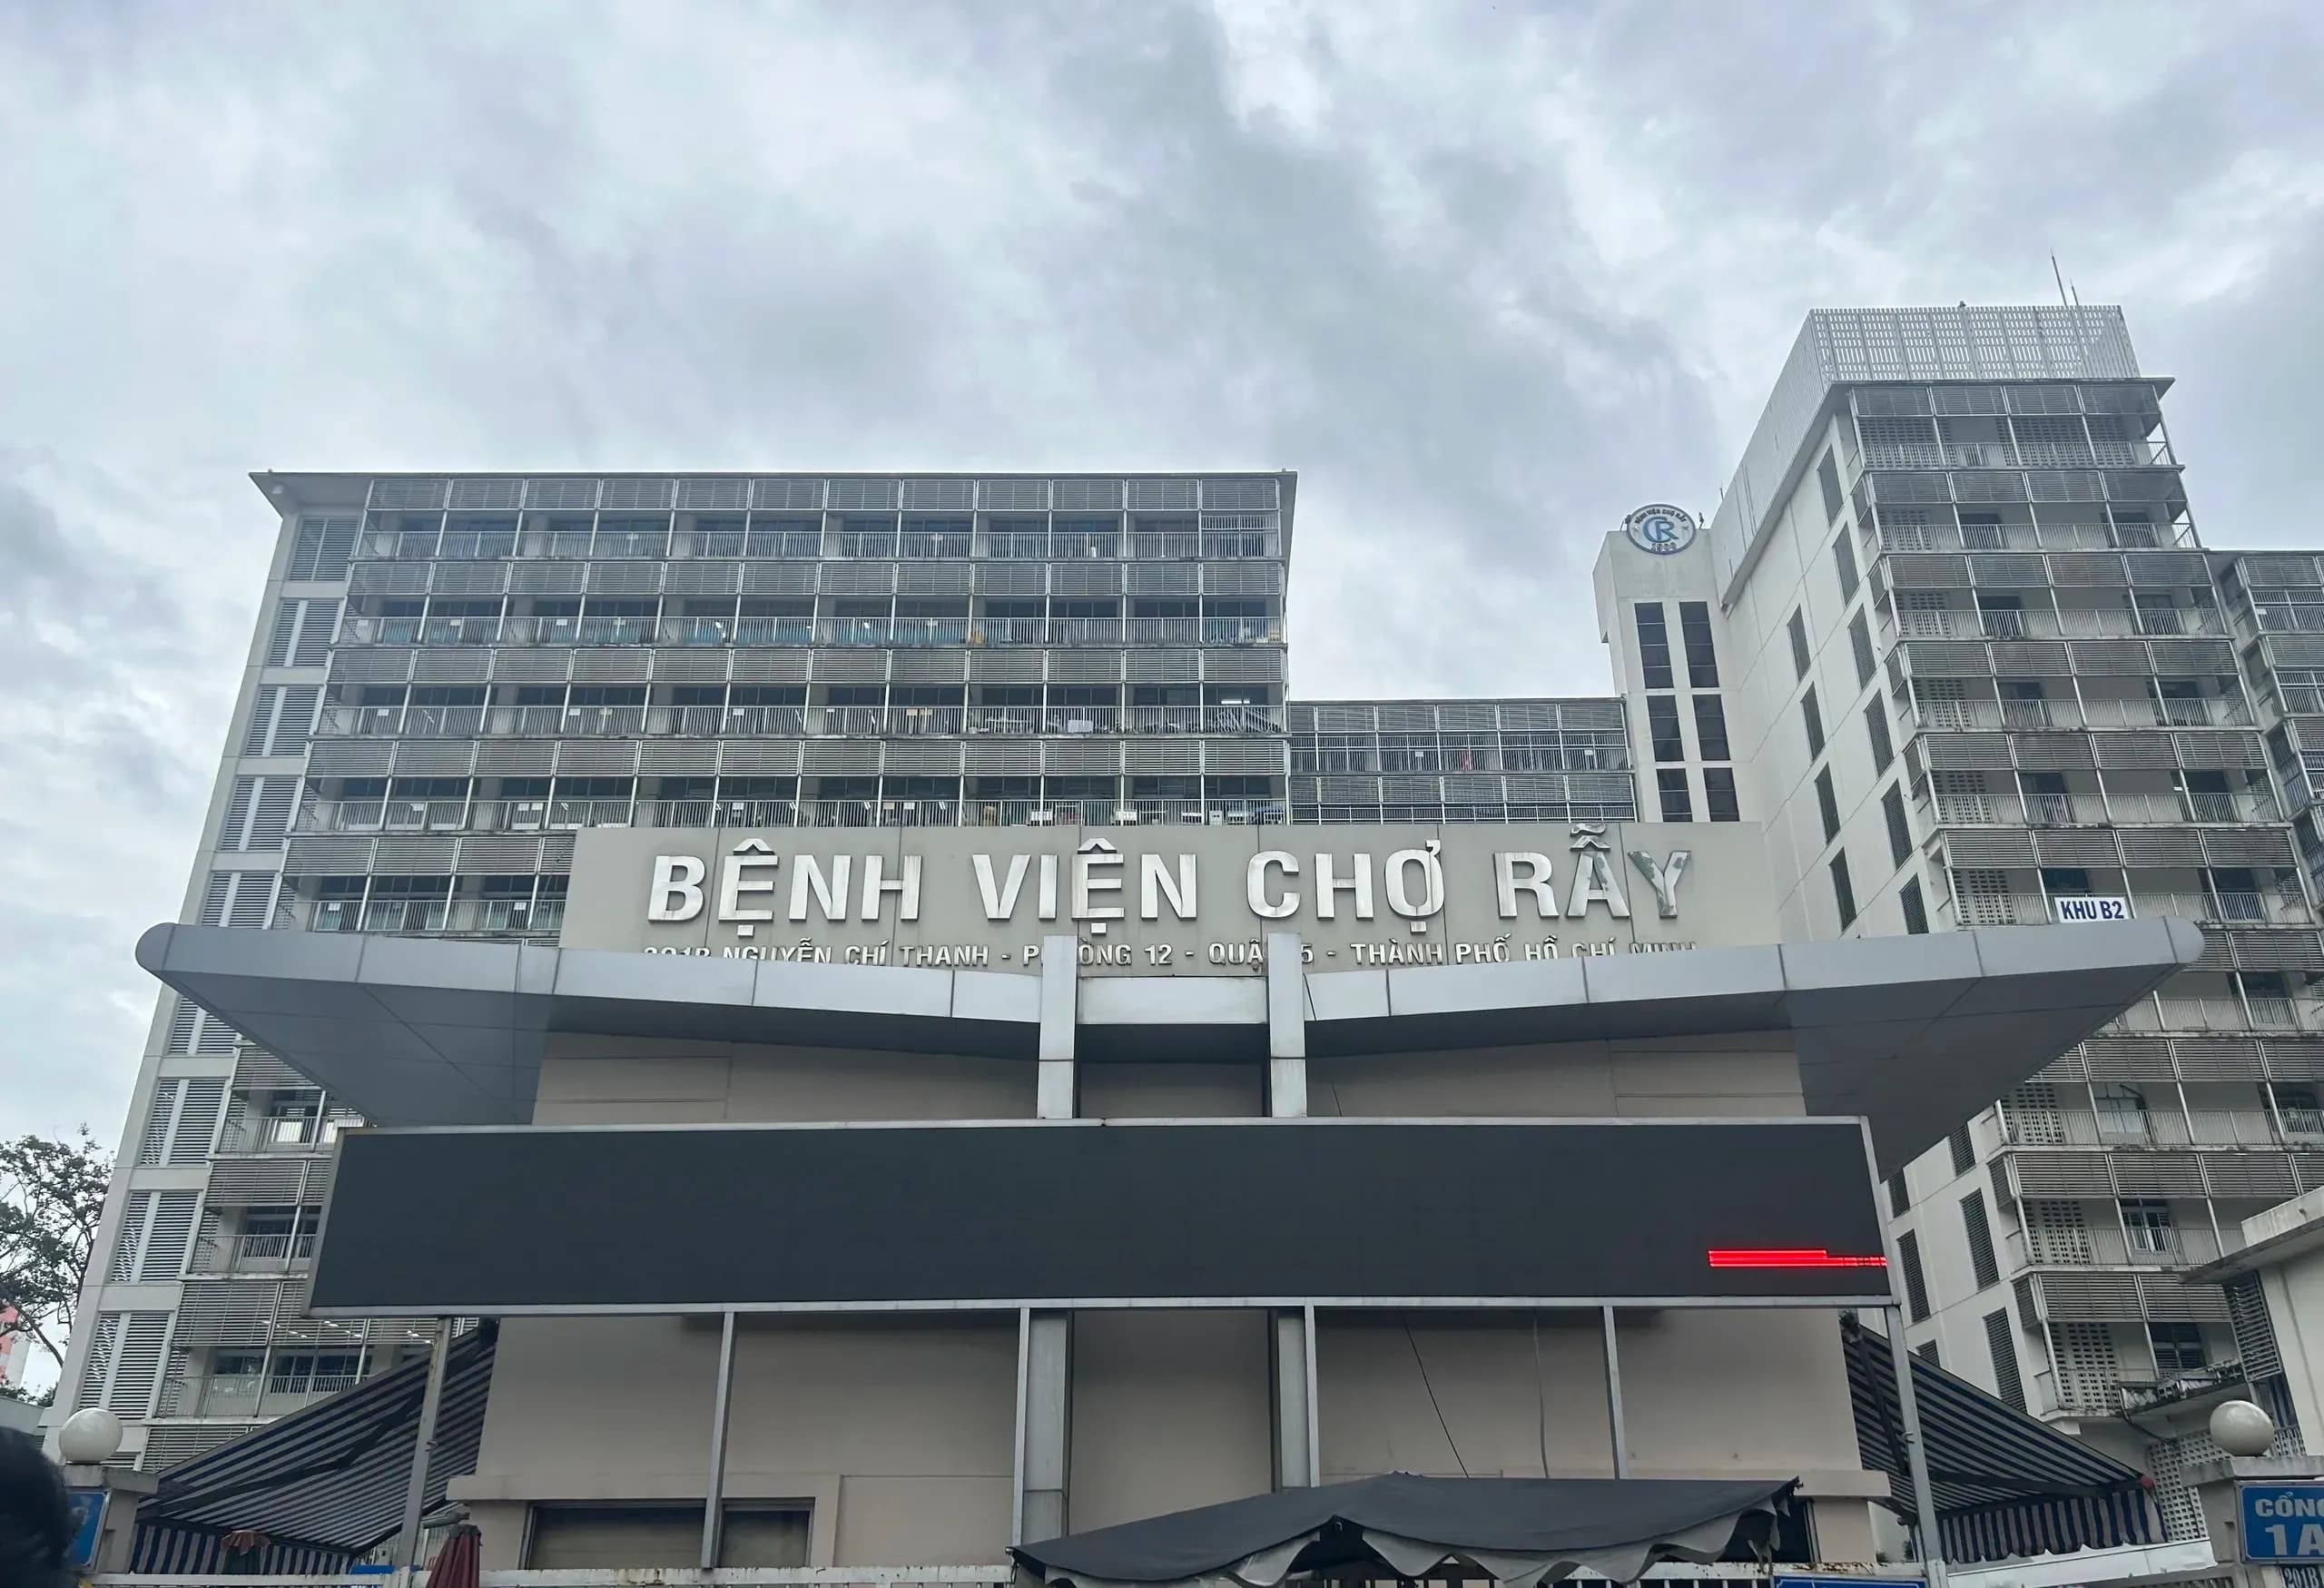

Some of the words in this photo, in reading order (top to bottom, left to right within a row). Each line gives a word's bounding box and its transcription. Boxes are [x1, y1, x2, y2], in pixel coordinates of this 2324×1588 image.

[647, 838, 923, 937] BỆNH
[971, 837, 1197, 935] VIỆN
[1246, 840, 1445, 933] CHỢ
[1493, 823, 1691, 919] RẪY
[2060, 901, 2097, 920] KHU
[2099, 901, 2124, 919] B2
[844, 940, 889, 965] CHÍ
[900, 945, 989, 967] THANH
[1022, 937, 1132, 966] PỜNG
[1145, 943, 1172, 966] 12
[1208, 938, 1264, 972] QUẬ
[1301, 943, 1314, 963] 5
[1350, 938, 1443, 964] THÀNH
[1454, 932, 1512, 963] PHỐ
[1524, 934, 1559, 961] HỒ
[2265, 1524, 2324, 1555] 1A
